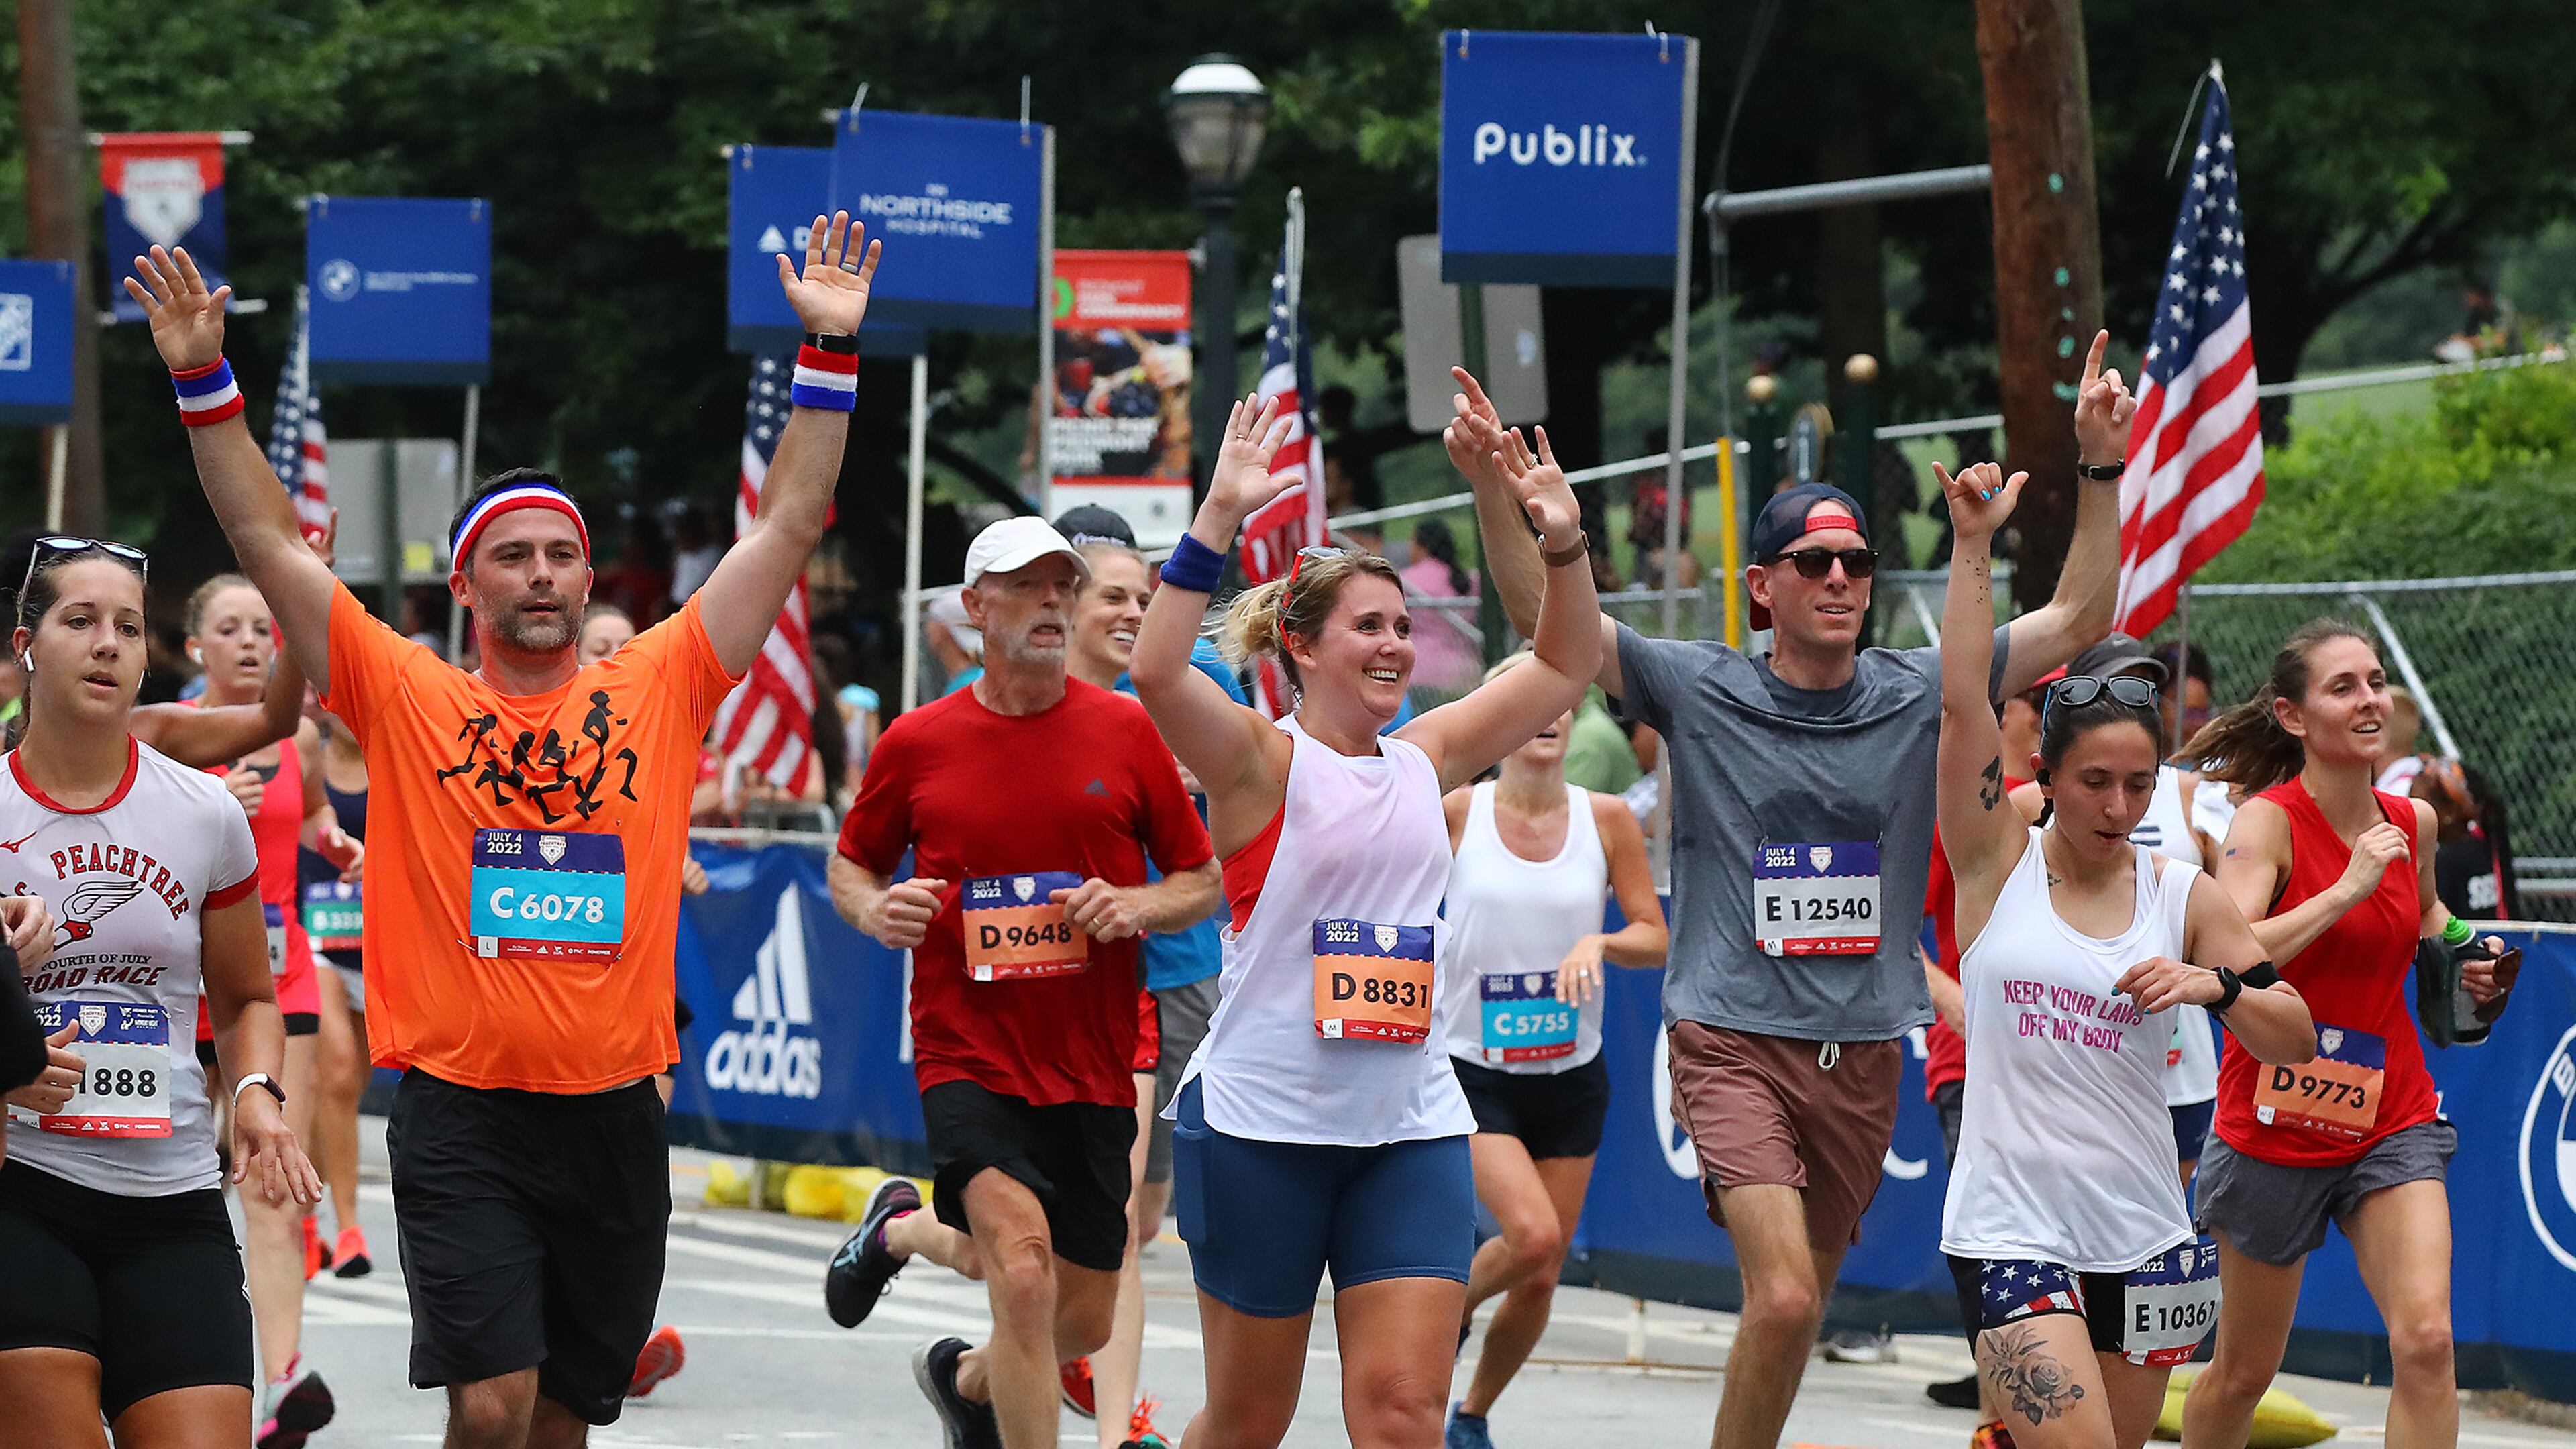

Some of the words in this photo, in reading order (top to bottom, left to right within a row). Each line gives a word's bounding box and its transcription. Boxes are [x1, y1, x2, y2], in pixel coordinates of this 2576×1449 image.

[859, 193, 1012, 225] NORTHSIDE
[486, 842, 522, 854] 2022
[488, 833, 511, 842] JULY
[515, 833, 522, 842] 4
[1766, 848, 1785, 857] JULY
[1789, 847, 1795, 855] 4
[1766, 857, 1796, 867] 2022
[50, 843, 189, 921] PEACHTREE
[972, 887, 1002, 899] 2022
[490, 886, 514, 918] C
[520, 894, 604, 923] 6078
[1766, 896, 1782, 922] E
[1792, 898, 1872, 921] 12540
[981, 924, 1000, 949] D
[1007, 922, 1071, 947] 9648
[1326, 922, 1348, 931] JULY
[1352, 922, 1359, 930] 4
[1326, 931, 1359, 942] 2022
[486, 942, 490, 950] L
[41, 955, 95, 971] FOURTH
[99, 954, 118, 963] OF
[120, 954, 152, 964] JULY
[22, 967, 88, 994] ROAD
[94, 966, 168, 986] RACE
[1332, 973, 1356, 1000] D
[1364, 979, 1427, 1008] 8831
[54, 1004, 61, 1014] 4
[2004, 979, 2043, 1005] KEEP
[2050, 985, 2096, 1017] YOUR
[36, 1014, 62, 1026] 022
[1494, 1013, 1512, 1036] C
[1516, 1012, 1569, 1035] 5755
[2019, 1012, 2048, 1036] OFF
[2053, 1018, 2079, 1042] MY
[2083, 1024, 2123, 1053] BODY
[706, 1020, 822, 1100] adidas
[78, 1068, 156, 1097] 1888
[2272, 1067, 2295, 1091] D
[2300, 1076, 2365, 1108] 9773
[2136, 1304, 2149, 1332] E
[2159, 1300, 2216, 1330] 10361
